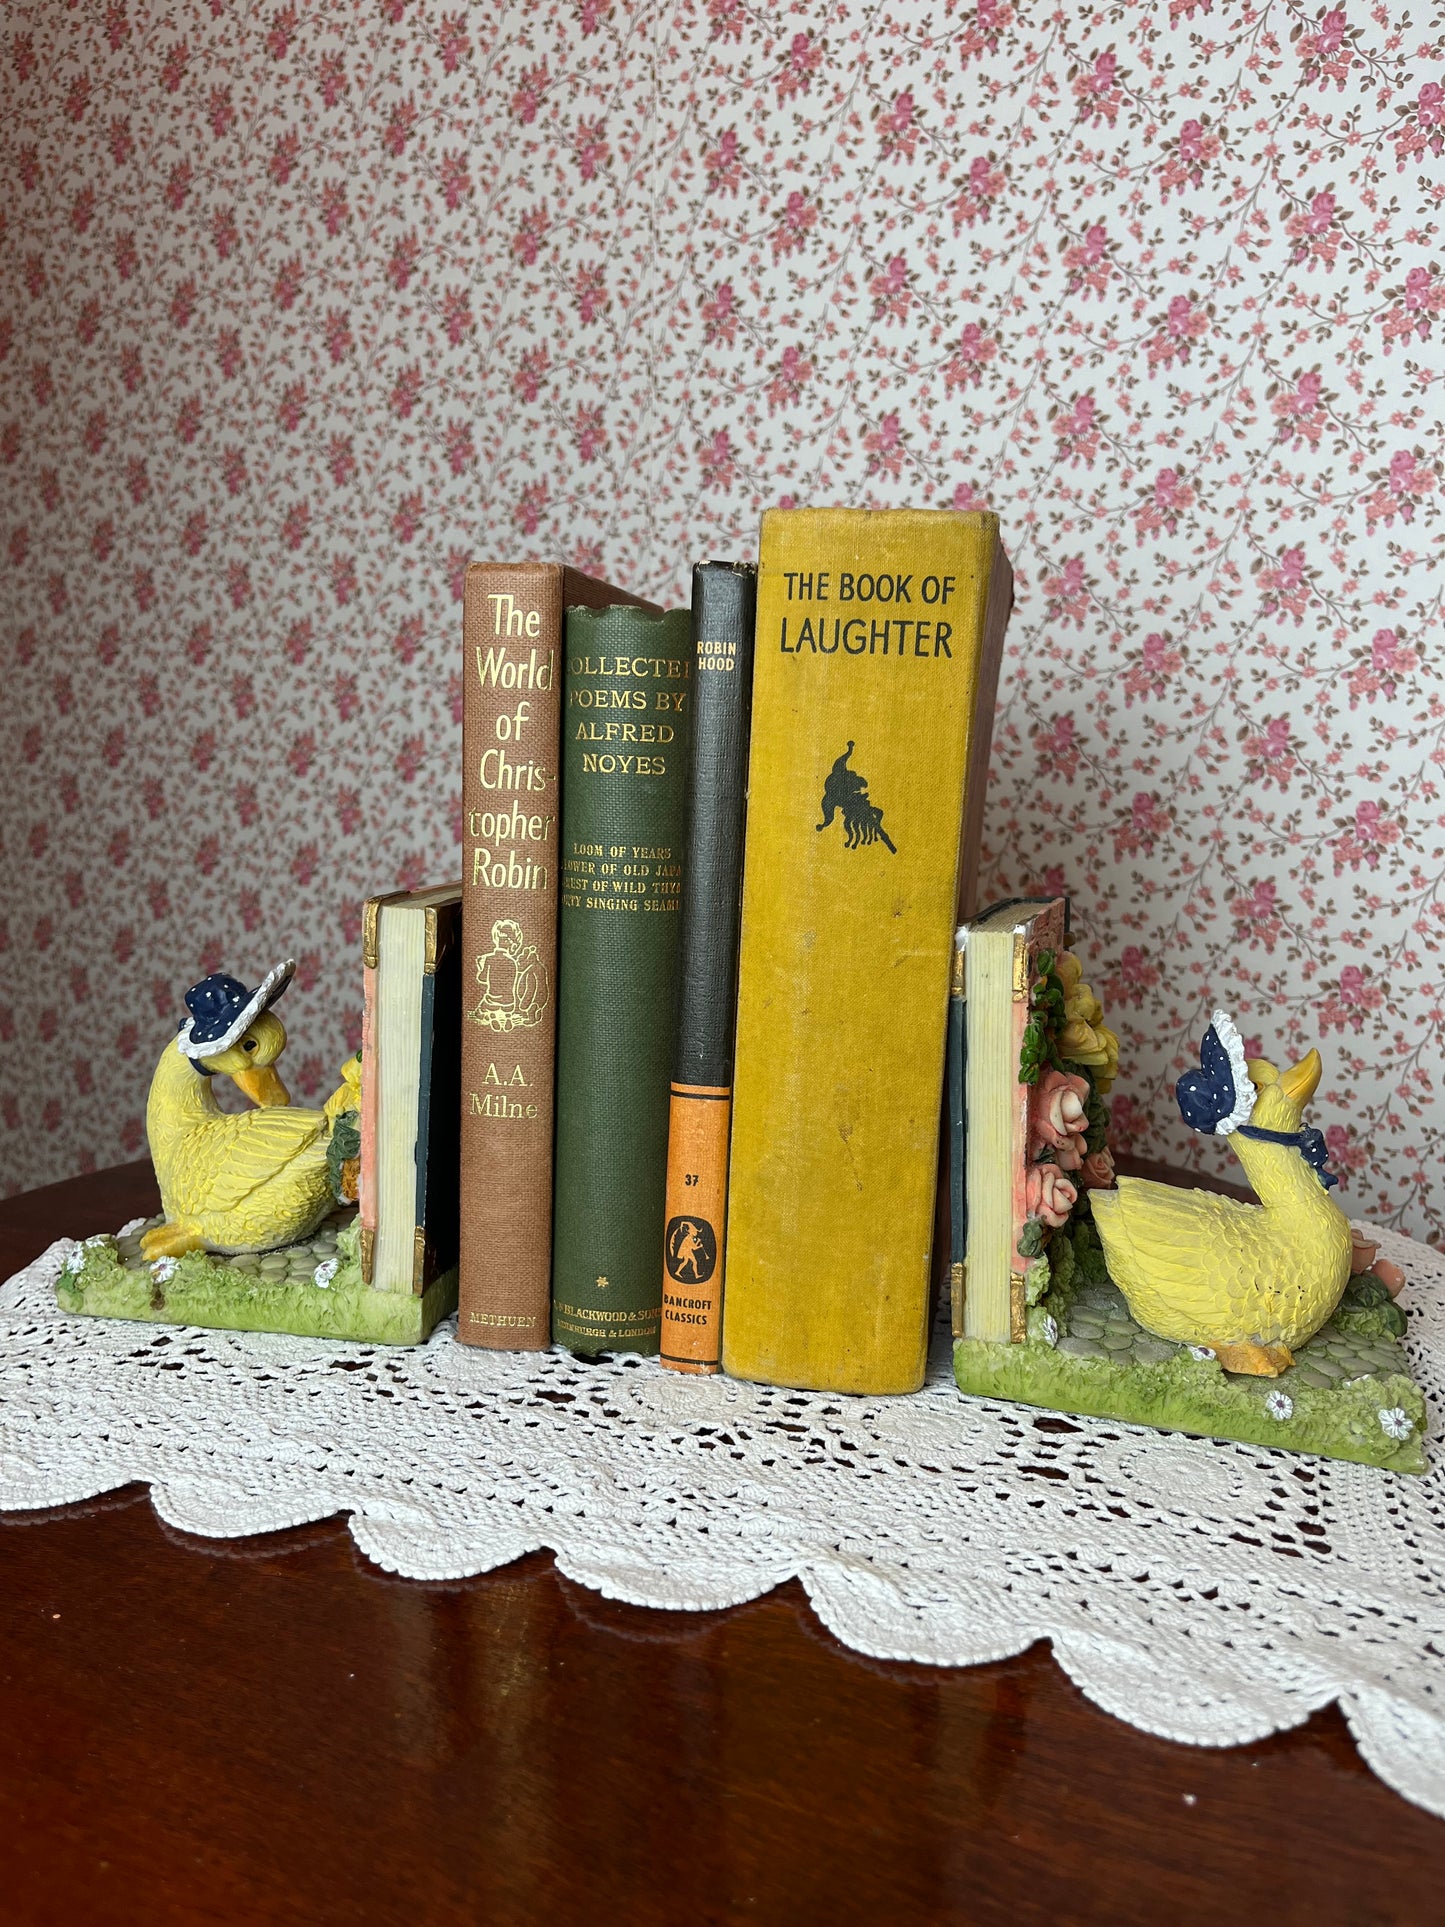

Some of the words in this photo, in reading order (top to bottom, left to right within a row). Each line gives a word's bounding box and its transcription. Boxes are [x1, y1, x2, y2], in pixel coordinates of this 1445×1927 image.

[783, 572, 830, 601] THE
[839, 572, 914, 603] BOOK
[921, 575, 956, 605] OF
[487, 593, 540, 637] The
[696, 640, 737, 656] ROBIN
[780, 617, 953, 659] LAUGHTER
[475, 646, 554, 691] World
[571, 656, 690, 679] OLLECTE
[698, 656, 735, 671] HOOD
[570, 688, 647, 710] POEMS
[655, 691, 687, 712] BY
[495, 701, 531, 741] of
[575, 721, 675, 744] ALFRED
[480, 748, 557, 792] Chris-
[582, 753, 666, 776] NOYES
[468, 799, 556, 847] topher
[573, 842, 604, 857] LOOM
[610, 845, 627, 859] OF
[632, 846, 671, 860] YEARS
[472, 847, 548, 890] Robin
[561, 860, 596, 875] LOWER
[601, 862, 618, 876] OF
[623, 864, 650, 877] OLD
[655, 864, 681, 877] JAPA
[592, 880, 609, 892] OF
[612, 881, 647, 894] WILD
[586, 896, 638, 912] SINGING
[482, 1062, 534, 1087] A.A.
[469, 1093, 538, 1119] Milne
[685, 1174, 699, 1187] 37
[563, 1303, 627, 1322] BLACKWOOD
[628, 1311, 637, 1321] &
[664, 1293, 712, 1311] BANCROFT
[469, 1311, 536, 1328] METHUEN
[665, 1309, 708, 1326] CLASSICS
[609, 1329, 617, 1338] &
[618, 1325, 657, 1338] LONDON
